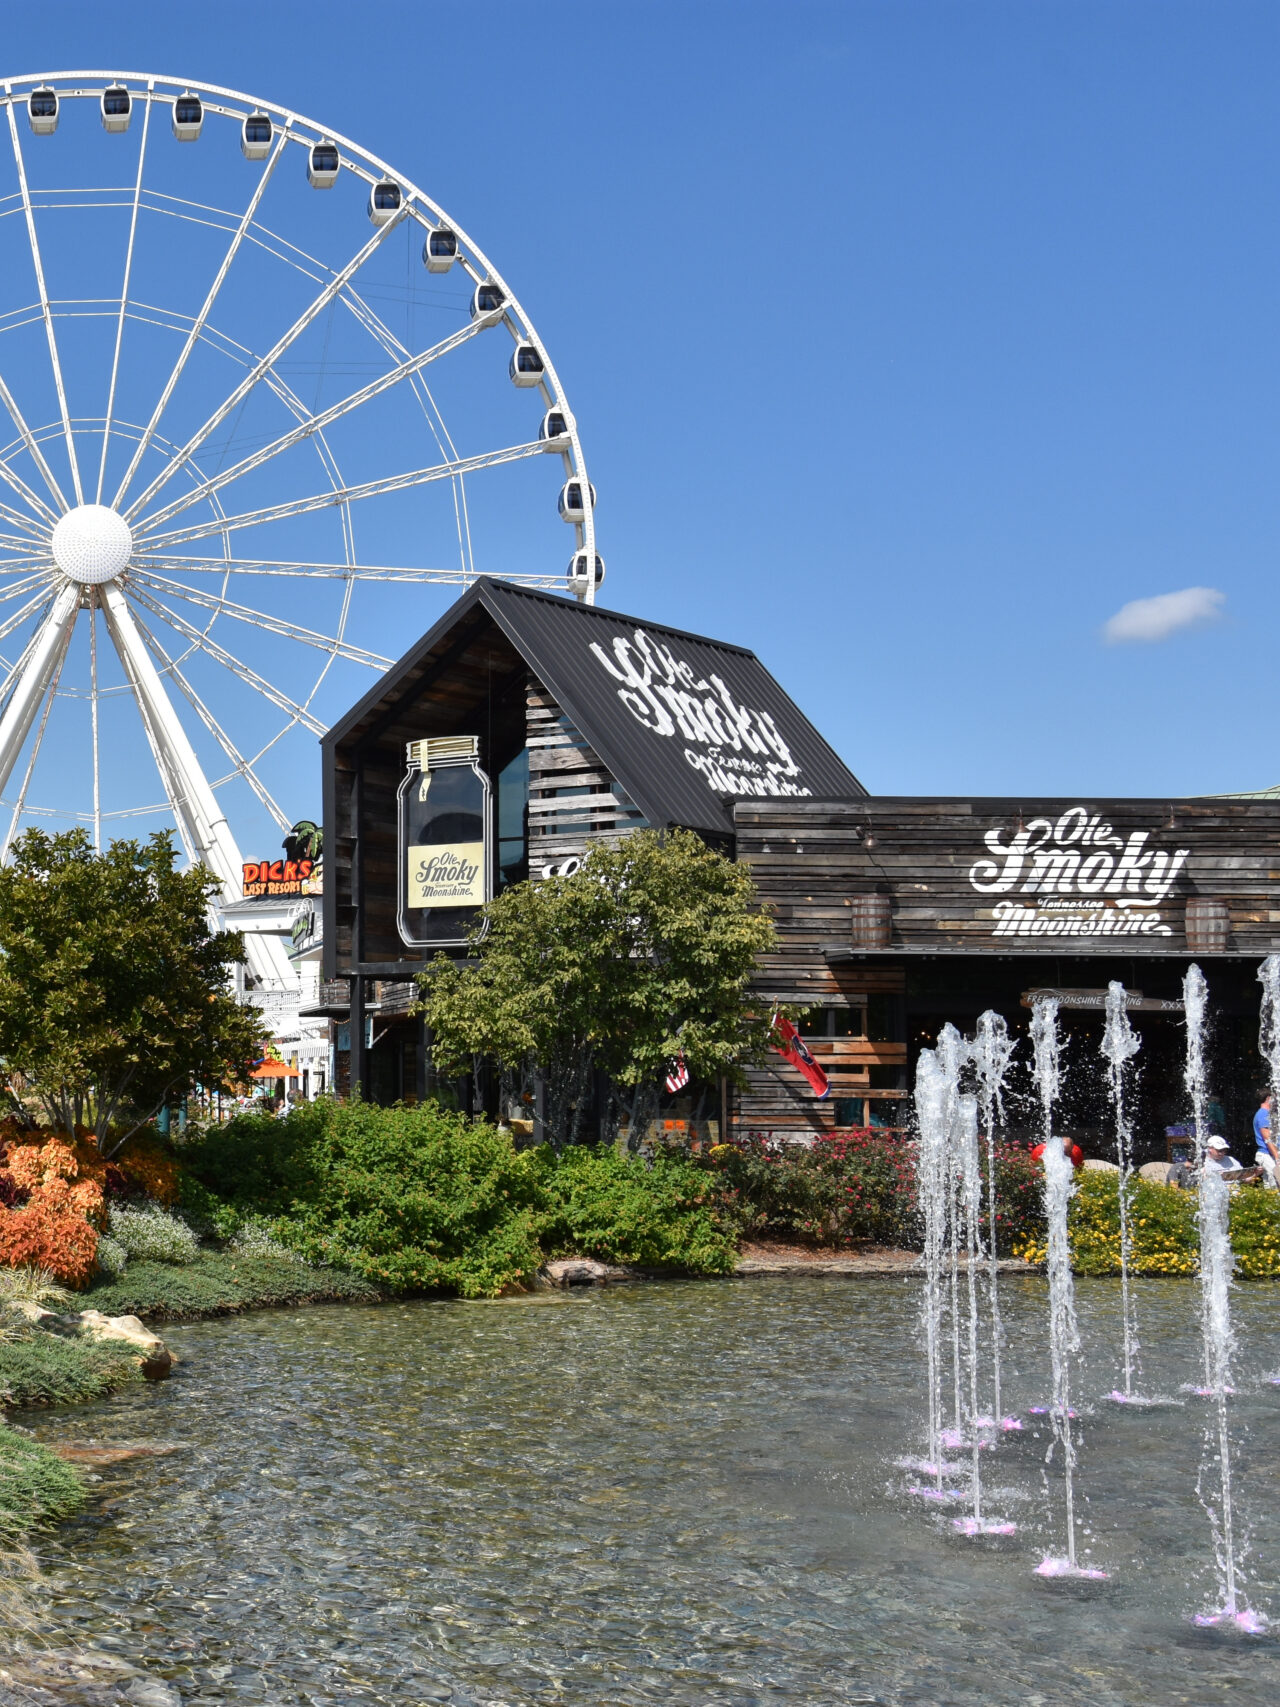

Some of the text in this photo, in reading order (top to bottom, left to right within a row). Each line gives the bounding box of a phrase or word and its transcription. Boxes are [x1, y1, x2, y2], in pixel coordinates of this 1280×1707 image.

[633, 628, 719, 698] Ole
[589, 637, 803, 777] Smoky
[1053, 807, 1124, 850] Ole
[243, 859, 313, 884] DICK'S
[416, 856, 480, 886] Smoky
[440, 852, 461, 866] Ole
[969, 819, 1191, 909] Smoky
[243, 880, 301, 896] LAST RESORT
[422, 885, 474, 898] Moonshine
[1037, 896, 1105, 912] Tennessee
[991, 901, 1173, 937] Moonshine
[1050, 995, 1102, 1005] MOONSHINE
